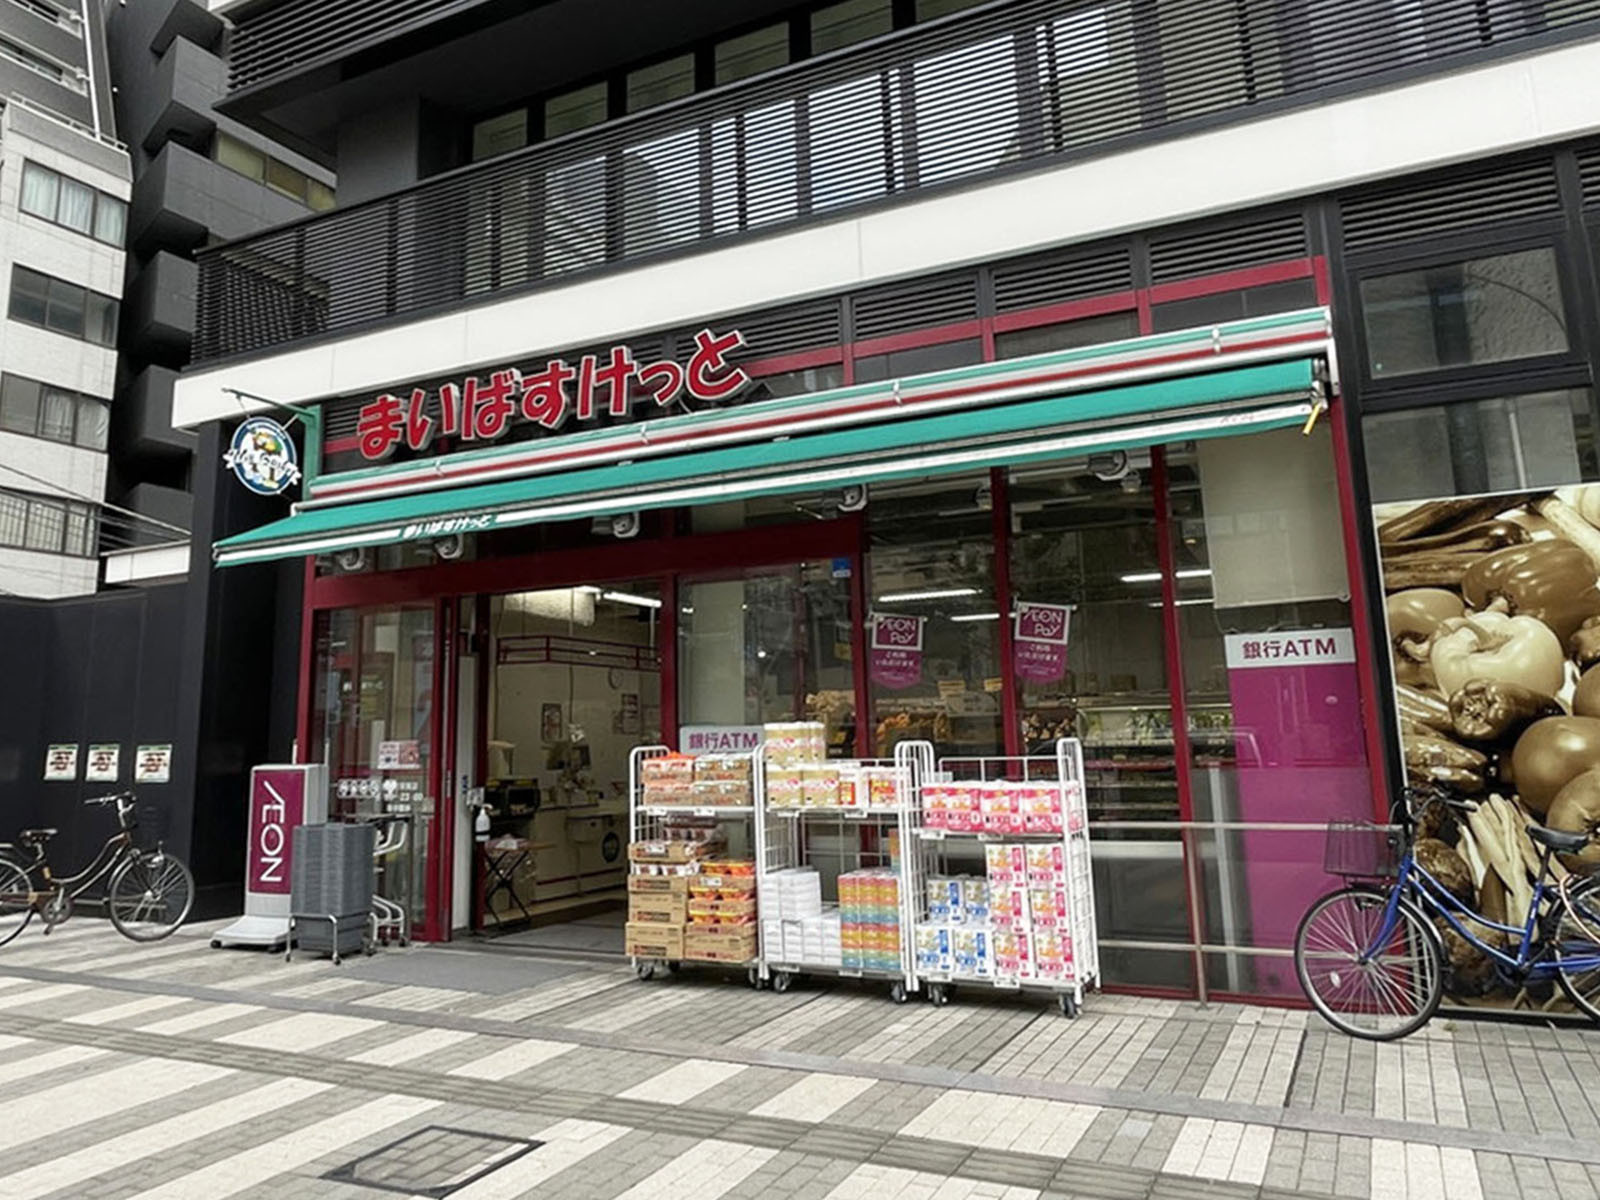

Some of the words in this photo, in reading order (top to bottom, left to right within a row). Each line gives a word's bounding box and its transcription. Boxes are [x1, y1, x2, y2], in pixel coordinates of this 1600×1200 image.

[357, 328, 749, 460] まいばすけっと
[403, 514, 492, 539] まいばすけっと
[879, 618, 917, 632] AEON
[1023, 608, 1063, 624] AEON
[1242, 637, 1337, 659] 銀行ATM
[688, 732, 759, 751] 銀行ATM
[260, 780, 285, 882] AEON
